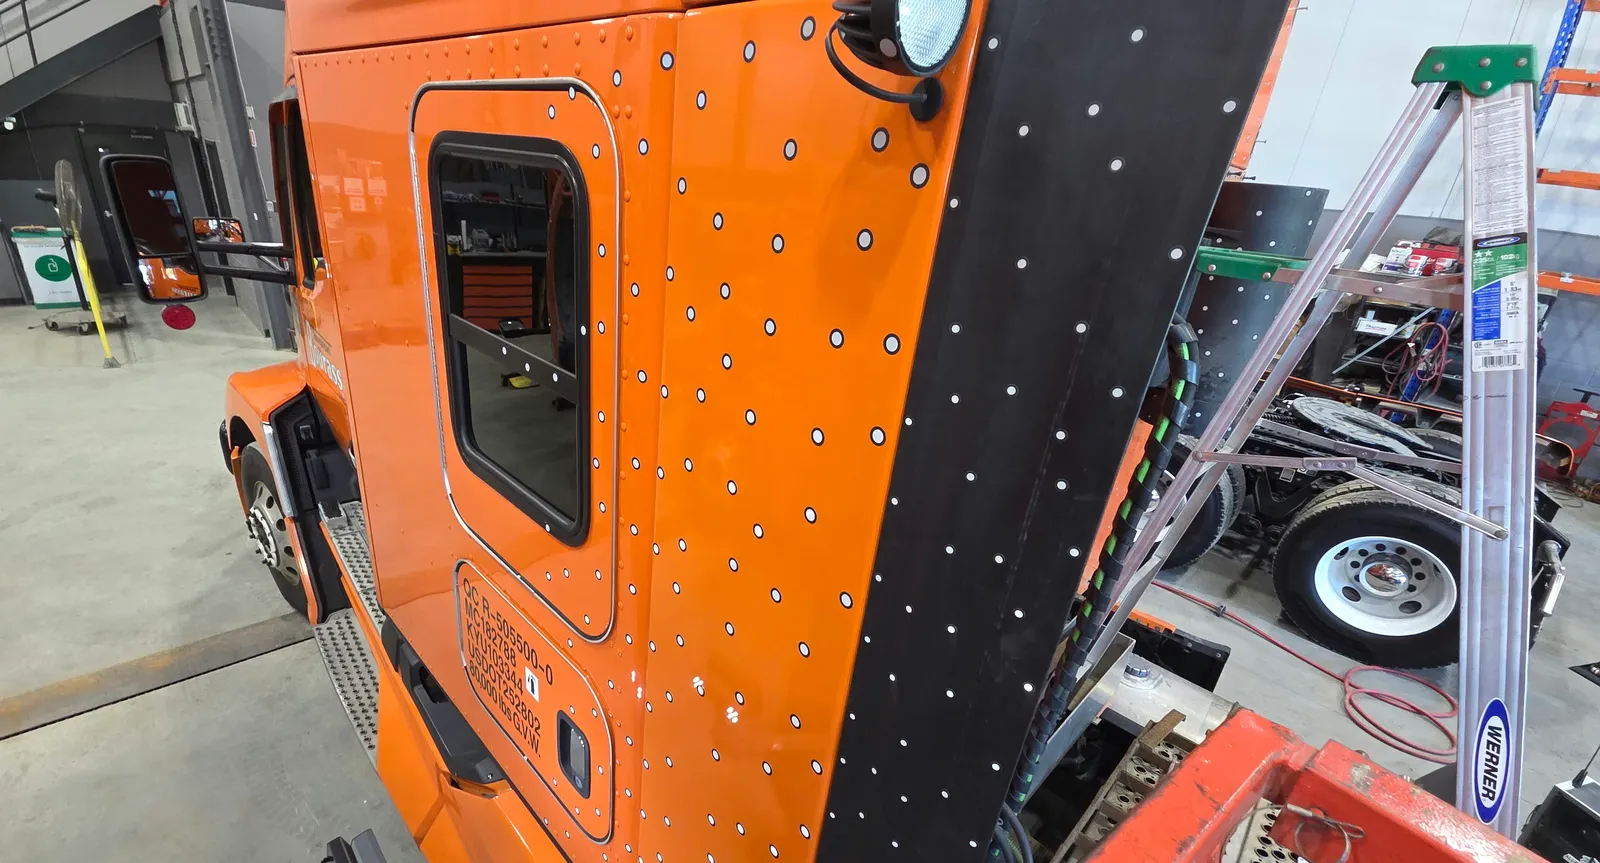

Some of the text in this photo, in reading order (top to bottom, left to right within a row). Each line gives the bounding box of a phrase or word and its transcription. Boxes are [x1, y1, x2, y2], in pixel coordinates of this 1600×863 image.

[463, 577, 554, 686] QC R-505500-0
[465, 598, 517, 668] MC182788
[466, 620, 524, 696] KYU103344
[467, 638, 542, 737] USDOT252802
[469, 661, 498, 704] 80,000
[1482, 725, 1502, 801] WERNER
